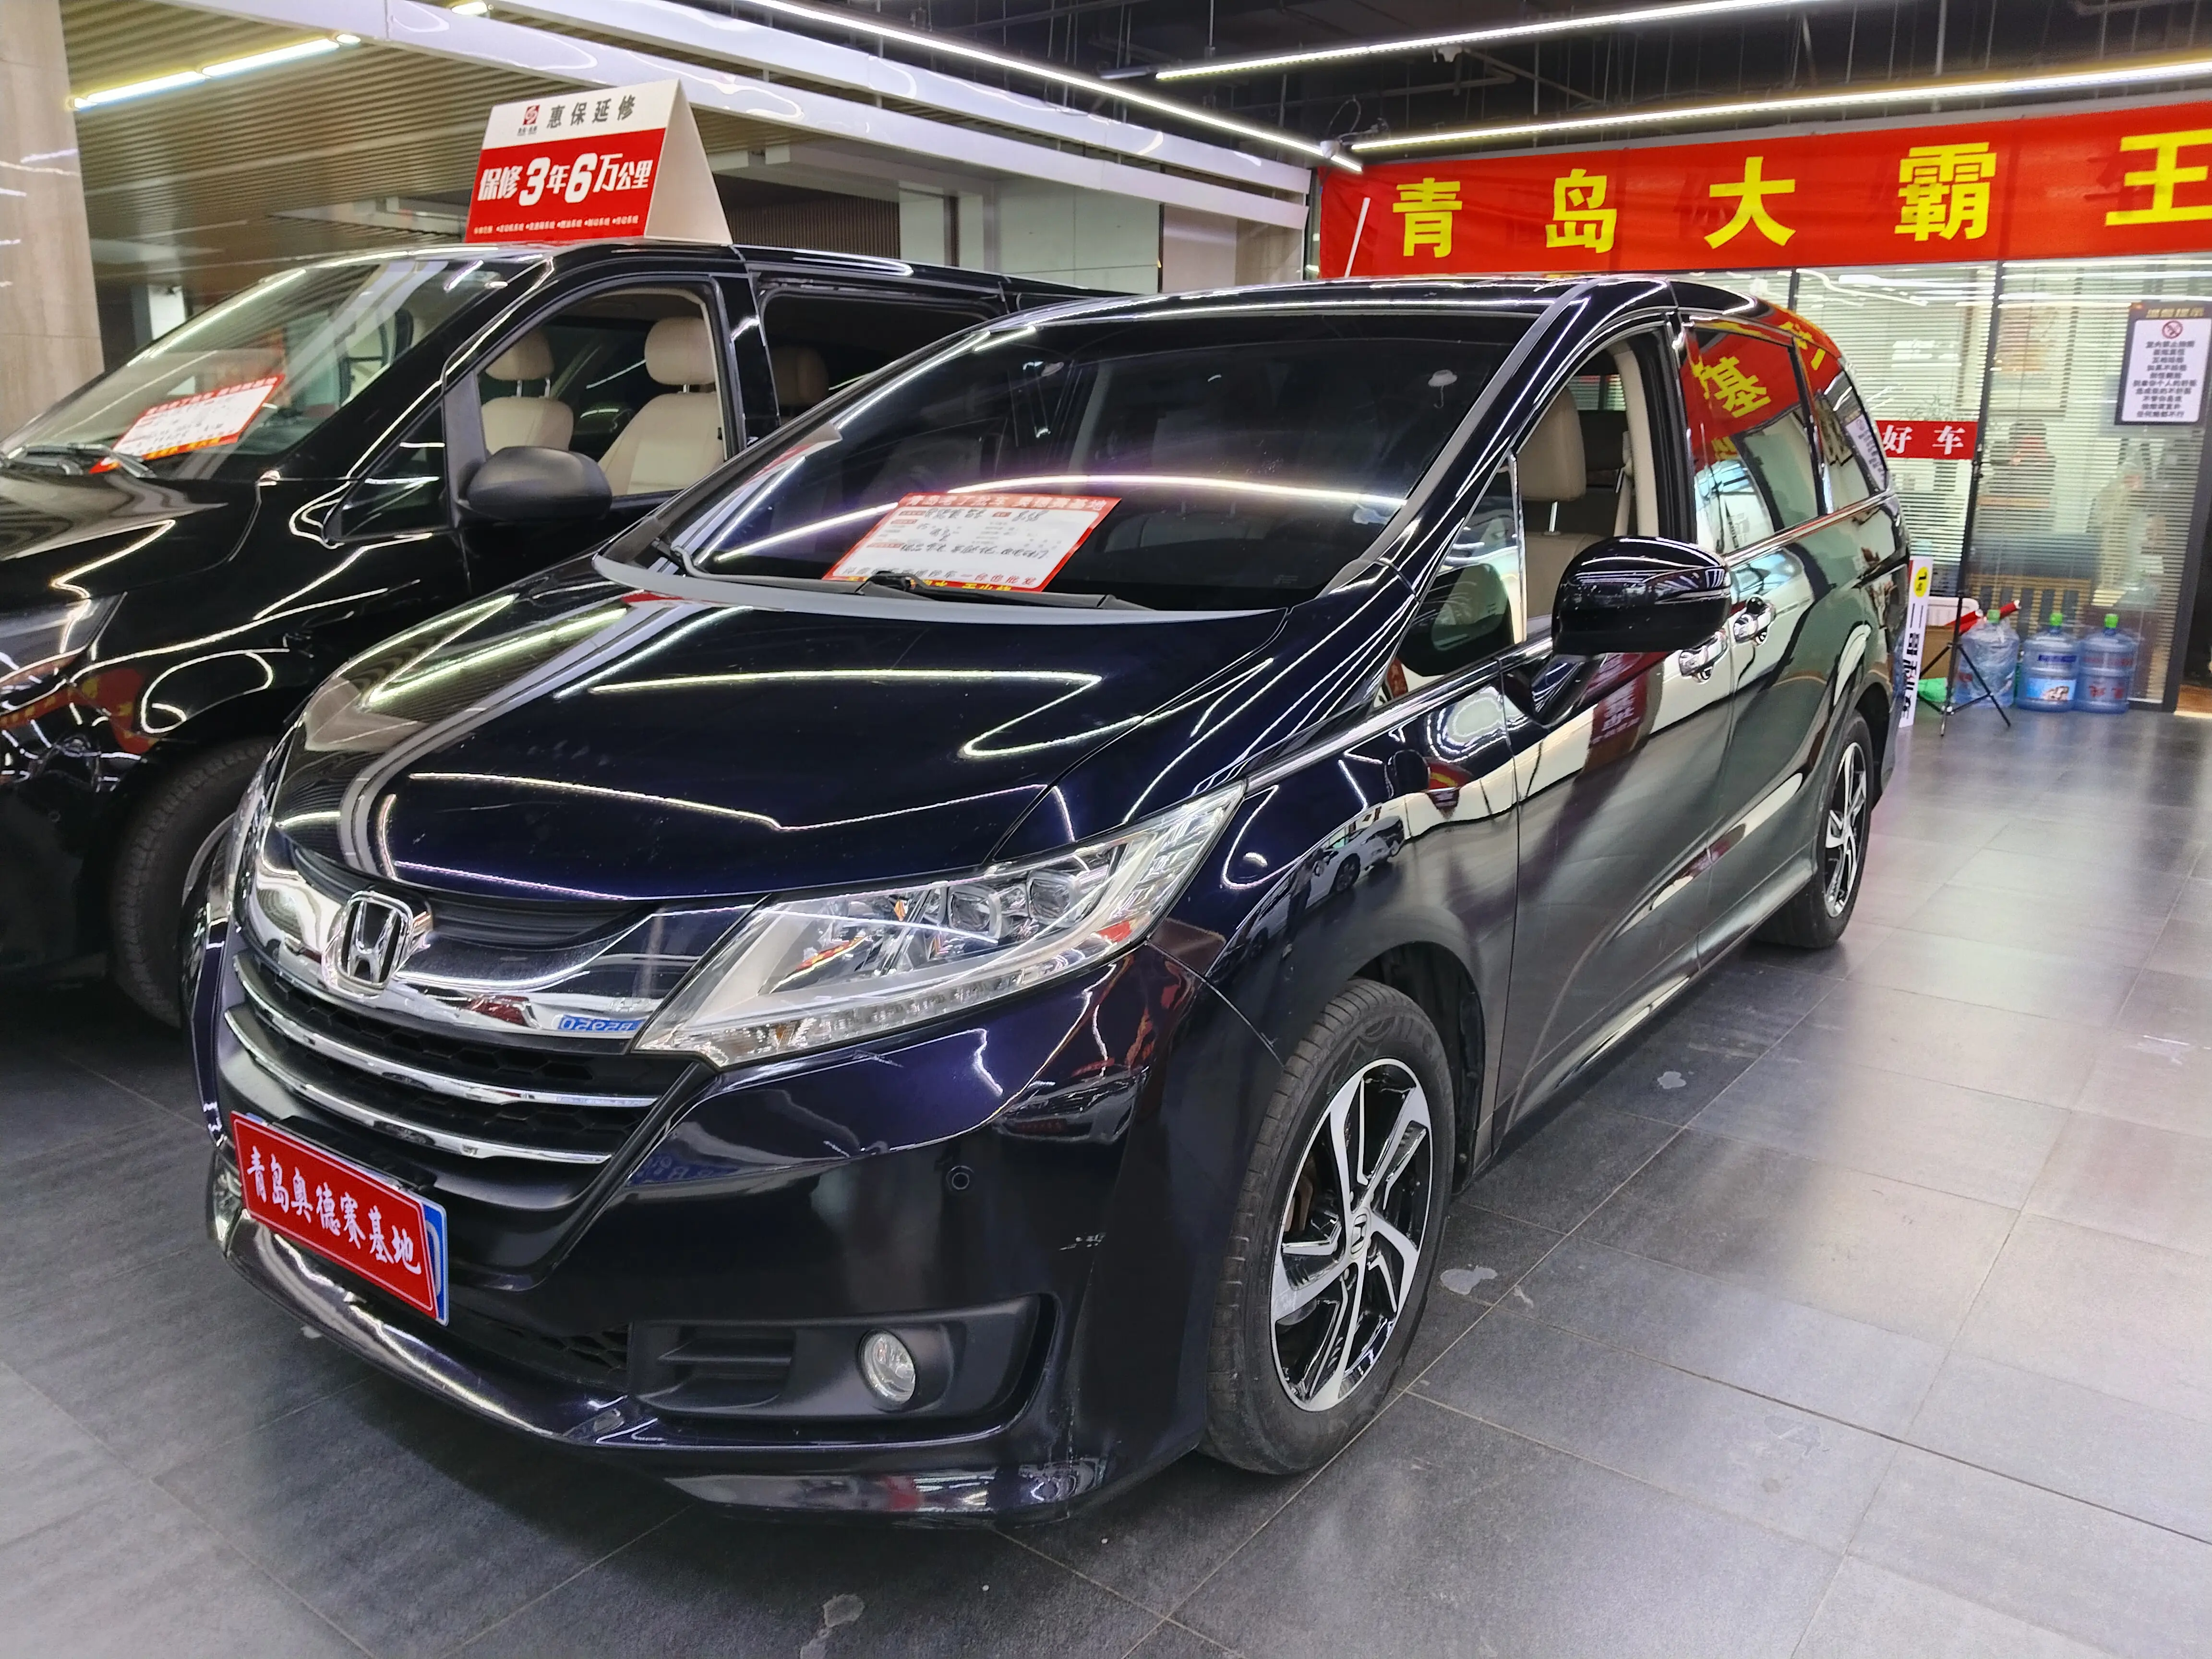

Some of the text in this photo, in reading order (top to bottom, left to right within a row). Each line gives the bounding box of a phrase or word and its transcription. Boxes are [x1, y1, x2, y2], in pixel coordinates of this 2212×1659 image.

[546, 94, 636, 129] 惠保延修
[477, 153, 653, 206] 保修3年6万公里
[1392, 130, 2212, 258] 青岛大霸王
[1882, 425, 1965, 455] 好车
[247, 1145, 422, 1275] 青岛奥德赛基地
